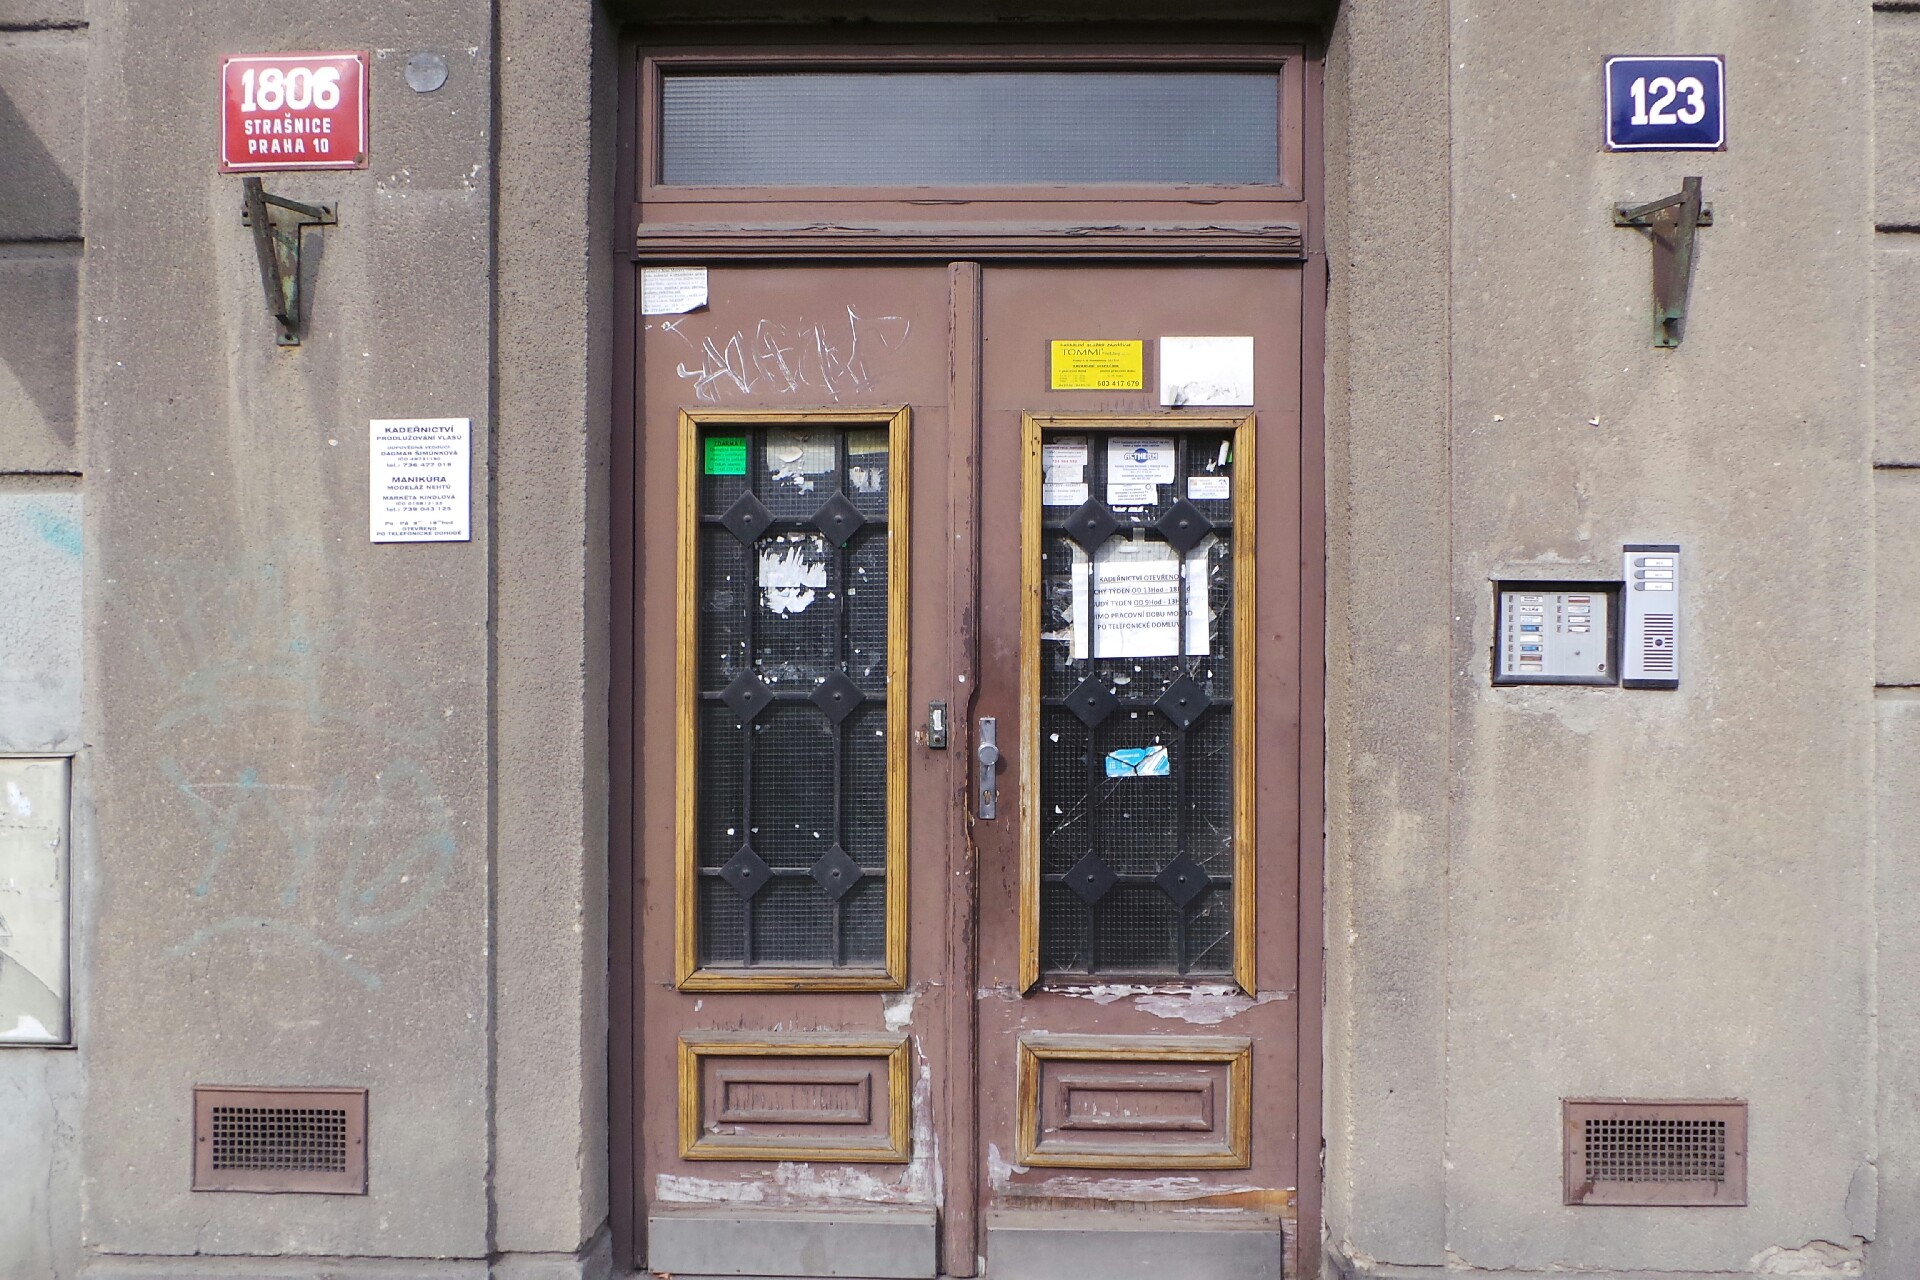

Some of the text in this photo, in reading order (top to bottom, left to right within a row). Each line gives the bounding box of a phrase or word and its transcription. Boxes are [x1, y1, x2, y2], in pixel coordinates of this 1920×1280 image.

[241, 66, 340, 112] 1806
[1630, 76, 1706, 125] 123
[244, 112, 331, 135] STRAŠNICE
[248, 138, 329, 154] PRAHA 10
[385, 425, 454, 433] KADEŘNICTVÍ
[392, 475, 446, 483] MANIKÚRA
[1099, 573, 1180, 583] KADEŘNICTVÍ OTEVŘENO
[1109, 586, 1130, 594] TÝDEN
[1111, 611, 1145, 619] PRACOVNÍ
[1109, 620, 1150, 629] TELEFONICKÉ
